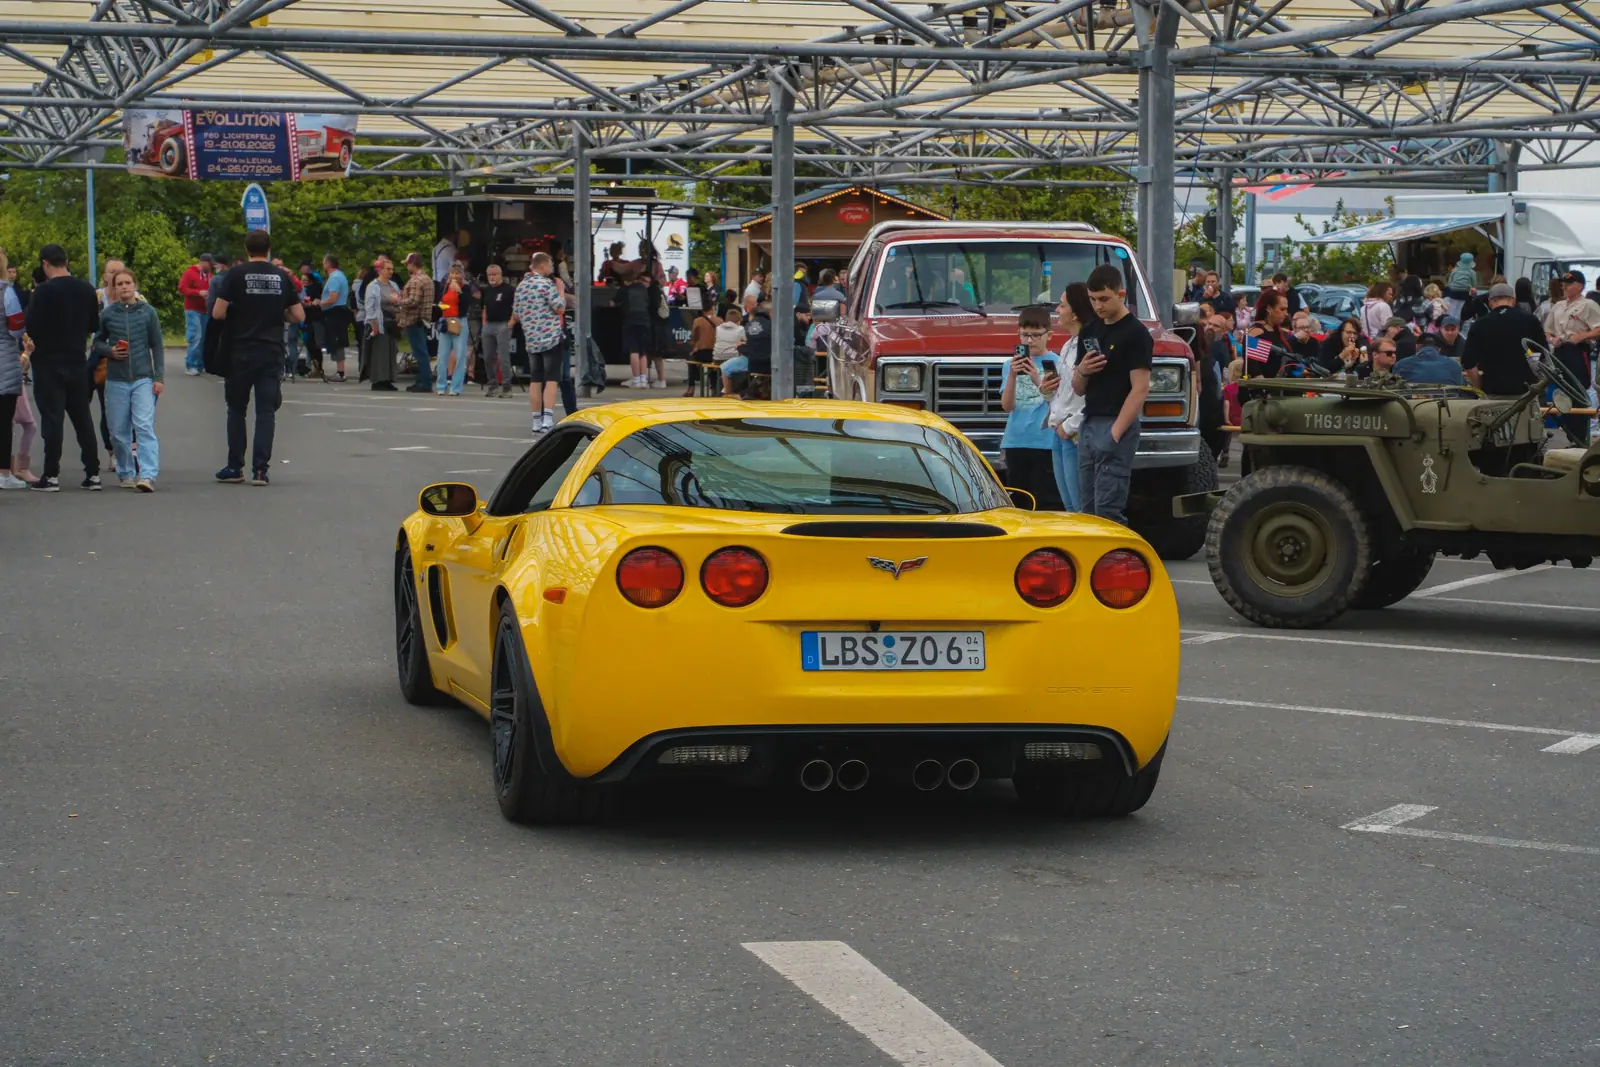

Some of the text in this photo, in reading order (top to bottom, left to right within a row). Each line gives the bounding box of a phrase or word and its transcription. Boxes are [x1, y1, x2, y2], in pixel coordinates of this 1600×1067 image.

[196, 110, 280, 127] EVOLUTION
[966, 636, 979, 645] 04
[807, 655, 814, 664] D
[820, 636, 879, 666] LBS
[968, 656, 980, 665] 10
[1044, 685, 1133, 696] CORVETTE
